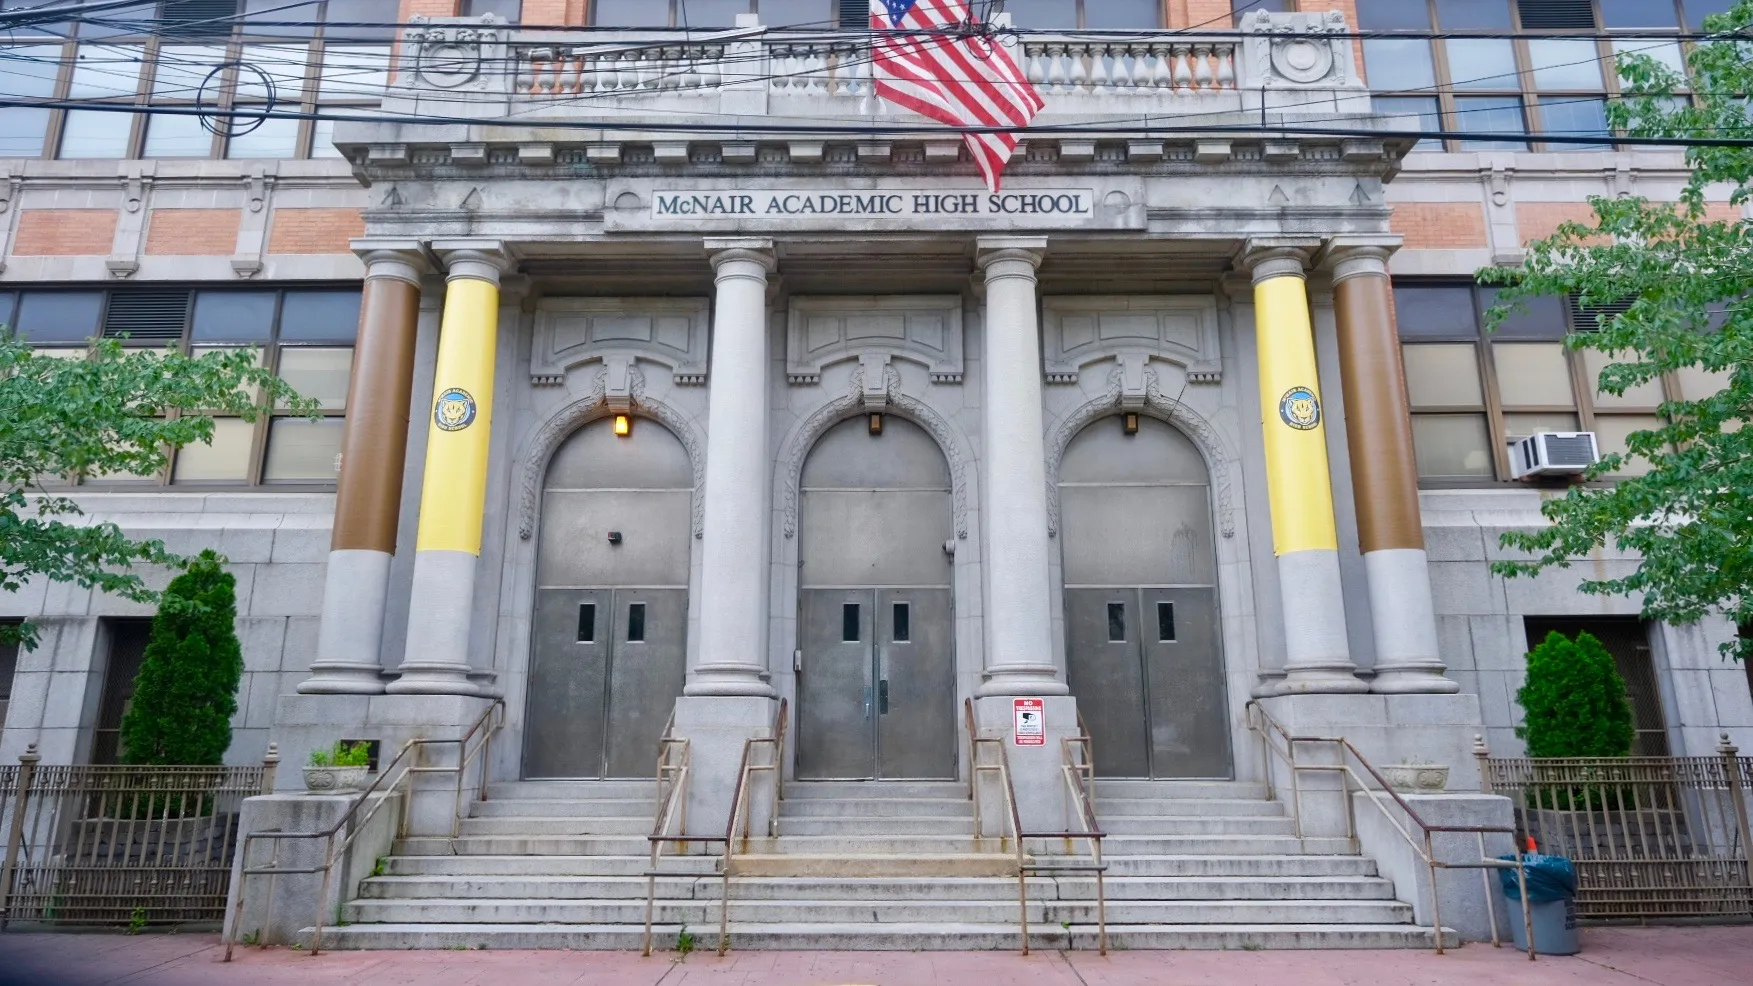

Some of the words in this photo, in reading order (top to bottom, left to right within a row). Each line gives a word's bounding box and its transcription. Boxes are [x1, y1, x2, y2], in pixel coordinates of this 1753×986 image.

[657, 195, 756, 214] McNAIR
[765, 195, 903, 214] ACADEMIC
[912, 194, 979, 213] HIGH
[988, 194, 1089, 213] SCHOOL
